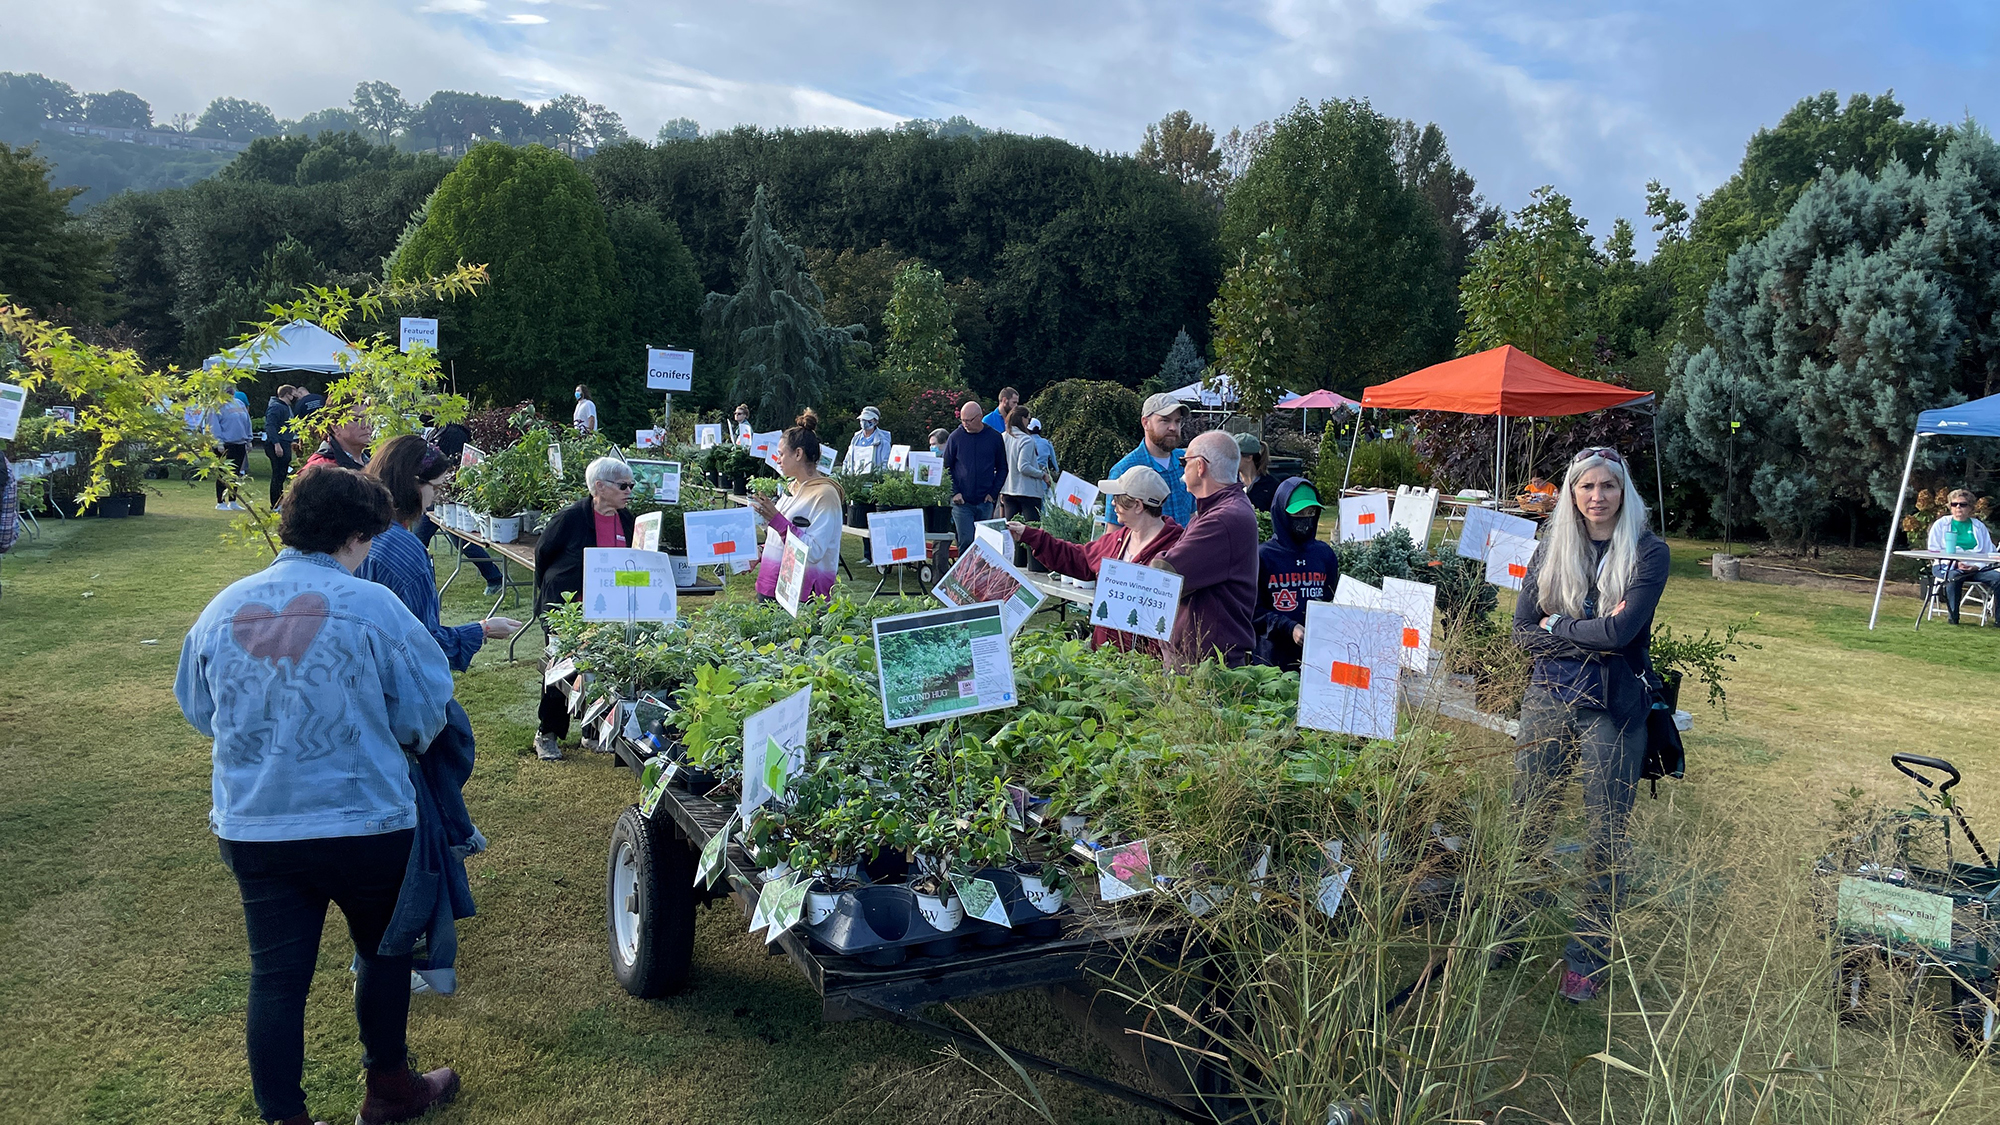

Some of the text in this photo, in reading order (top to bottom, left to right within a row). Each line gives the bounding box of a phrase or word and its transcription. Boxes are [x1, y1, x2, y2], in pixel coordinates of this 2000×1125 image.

[403, 327, 435, 335] Featured
[408, 336, 430, 344] Plants
[649, 368, 691, 380] Conifers
[1104, 576, 1128, 587] Proven
[1129, 581, 1152, 592] Winner
[1152, 587, 1173, 599] Quarts
[1107, 588, 1166, 610] $13 or 3/$33!
[897, 691, 931, 704] GROUND
[931, 689, 949, 699] HUG
[1870, 886, 1910, 900] SPONSORED
[1916, 910, 1936, 921] Blair
